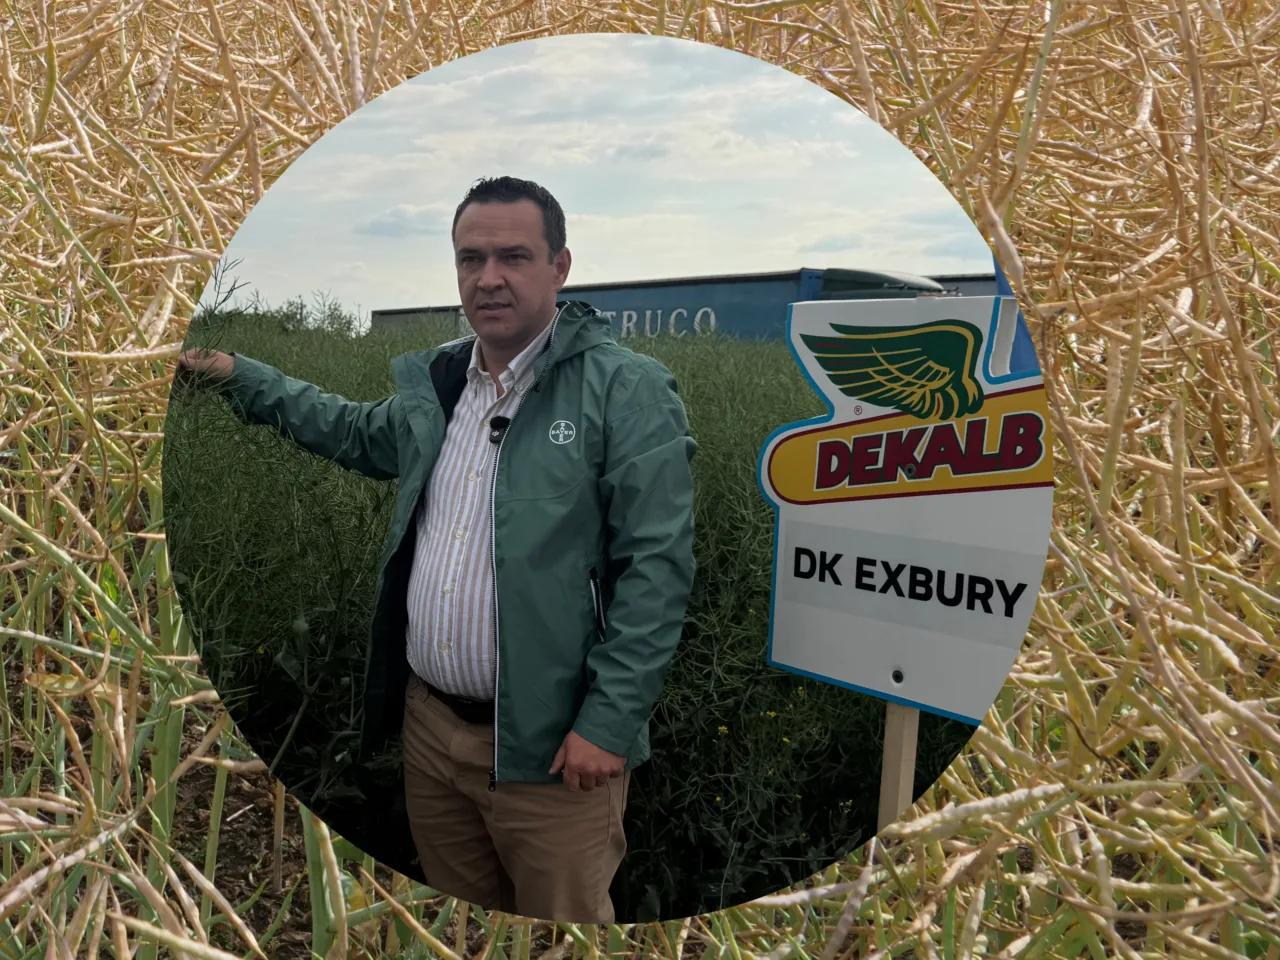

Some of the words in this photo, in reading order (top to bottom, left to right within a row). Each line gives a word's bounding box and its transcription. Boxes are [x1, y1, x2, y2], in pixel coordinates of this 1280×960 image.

[814, 412, 1045, 491] DEKALB
[793, 546, 844, 586] DK
[855, 556, 1028, 619] EXBURY
